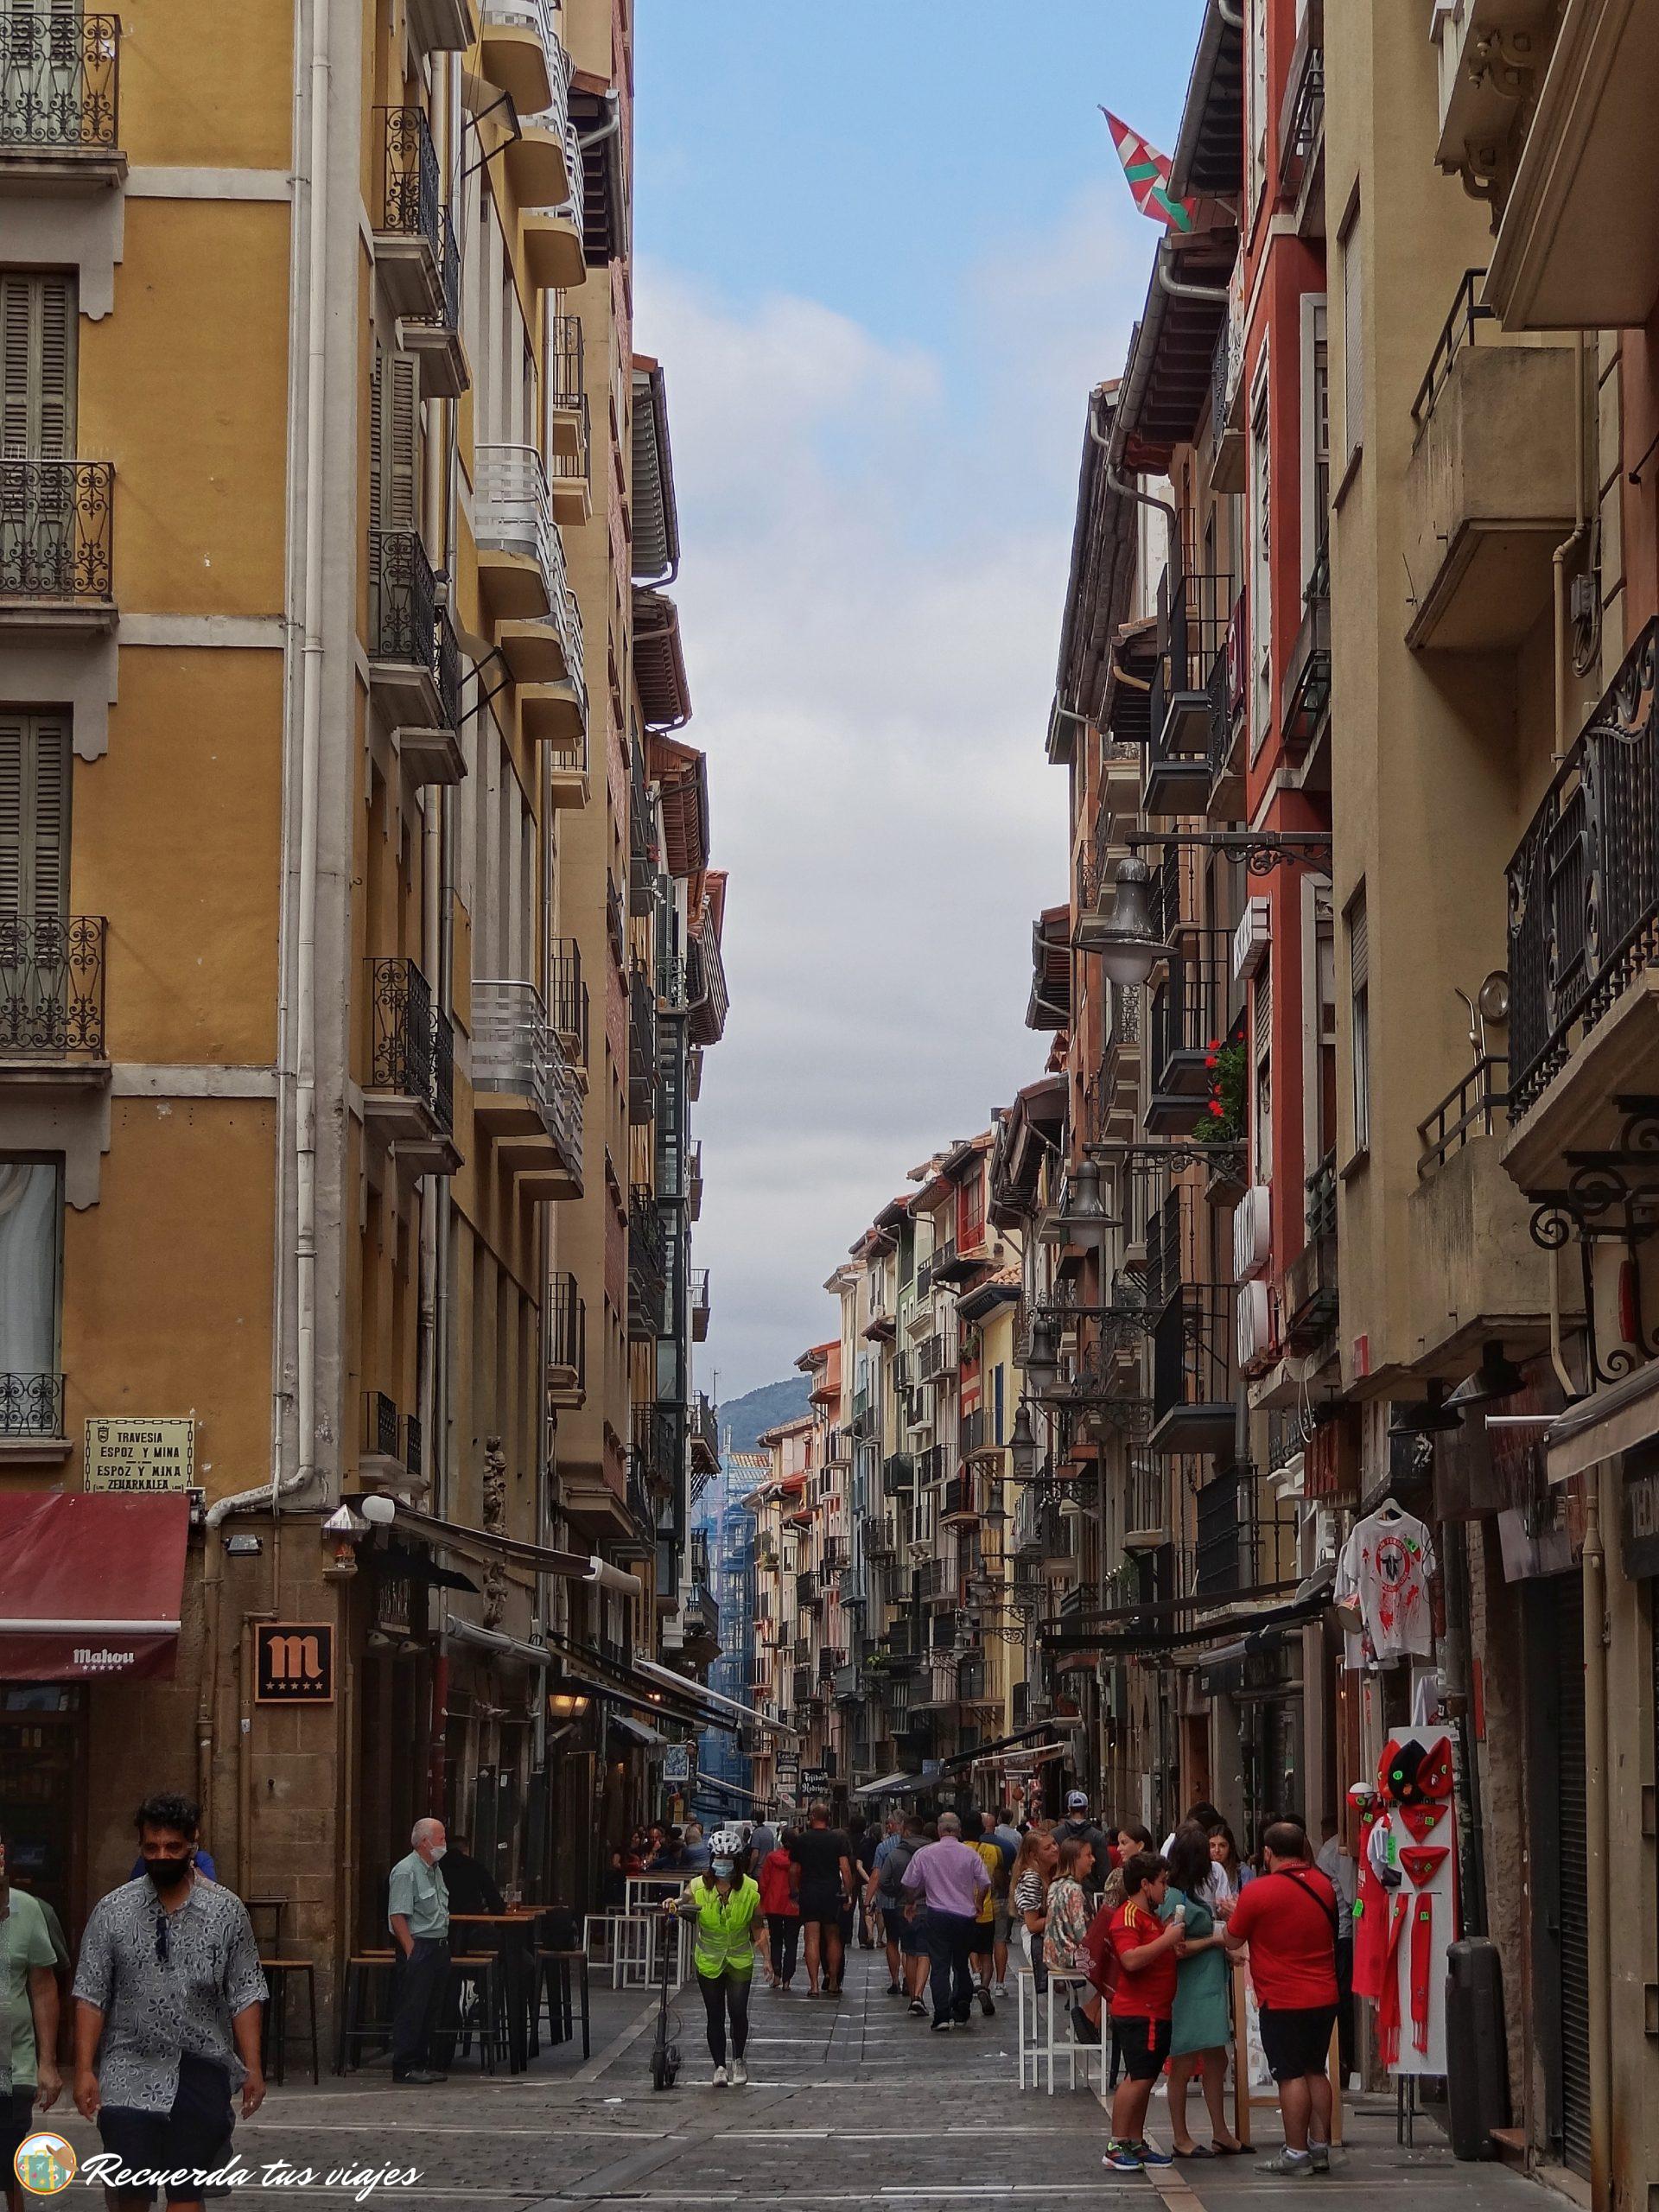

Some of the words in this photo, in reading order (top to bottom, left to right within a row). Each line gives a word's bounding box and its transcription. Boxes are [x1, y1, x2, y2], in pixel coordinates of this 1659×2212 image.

[117, 1432, 162, 1443] TRAVESIA
[100, 1446, 134, 1458] ESPOZ
[142, 1446, 149, 1458] Y
[153, 1446, 180, 1458] MINA
[97, 1465, 131, 1477] ESPOZ
[137, 1465, 145, 1477] Y
[151, 1465, 181, 1477] MINA
[73, 1649, 135, 1664] Mahou
